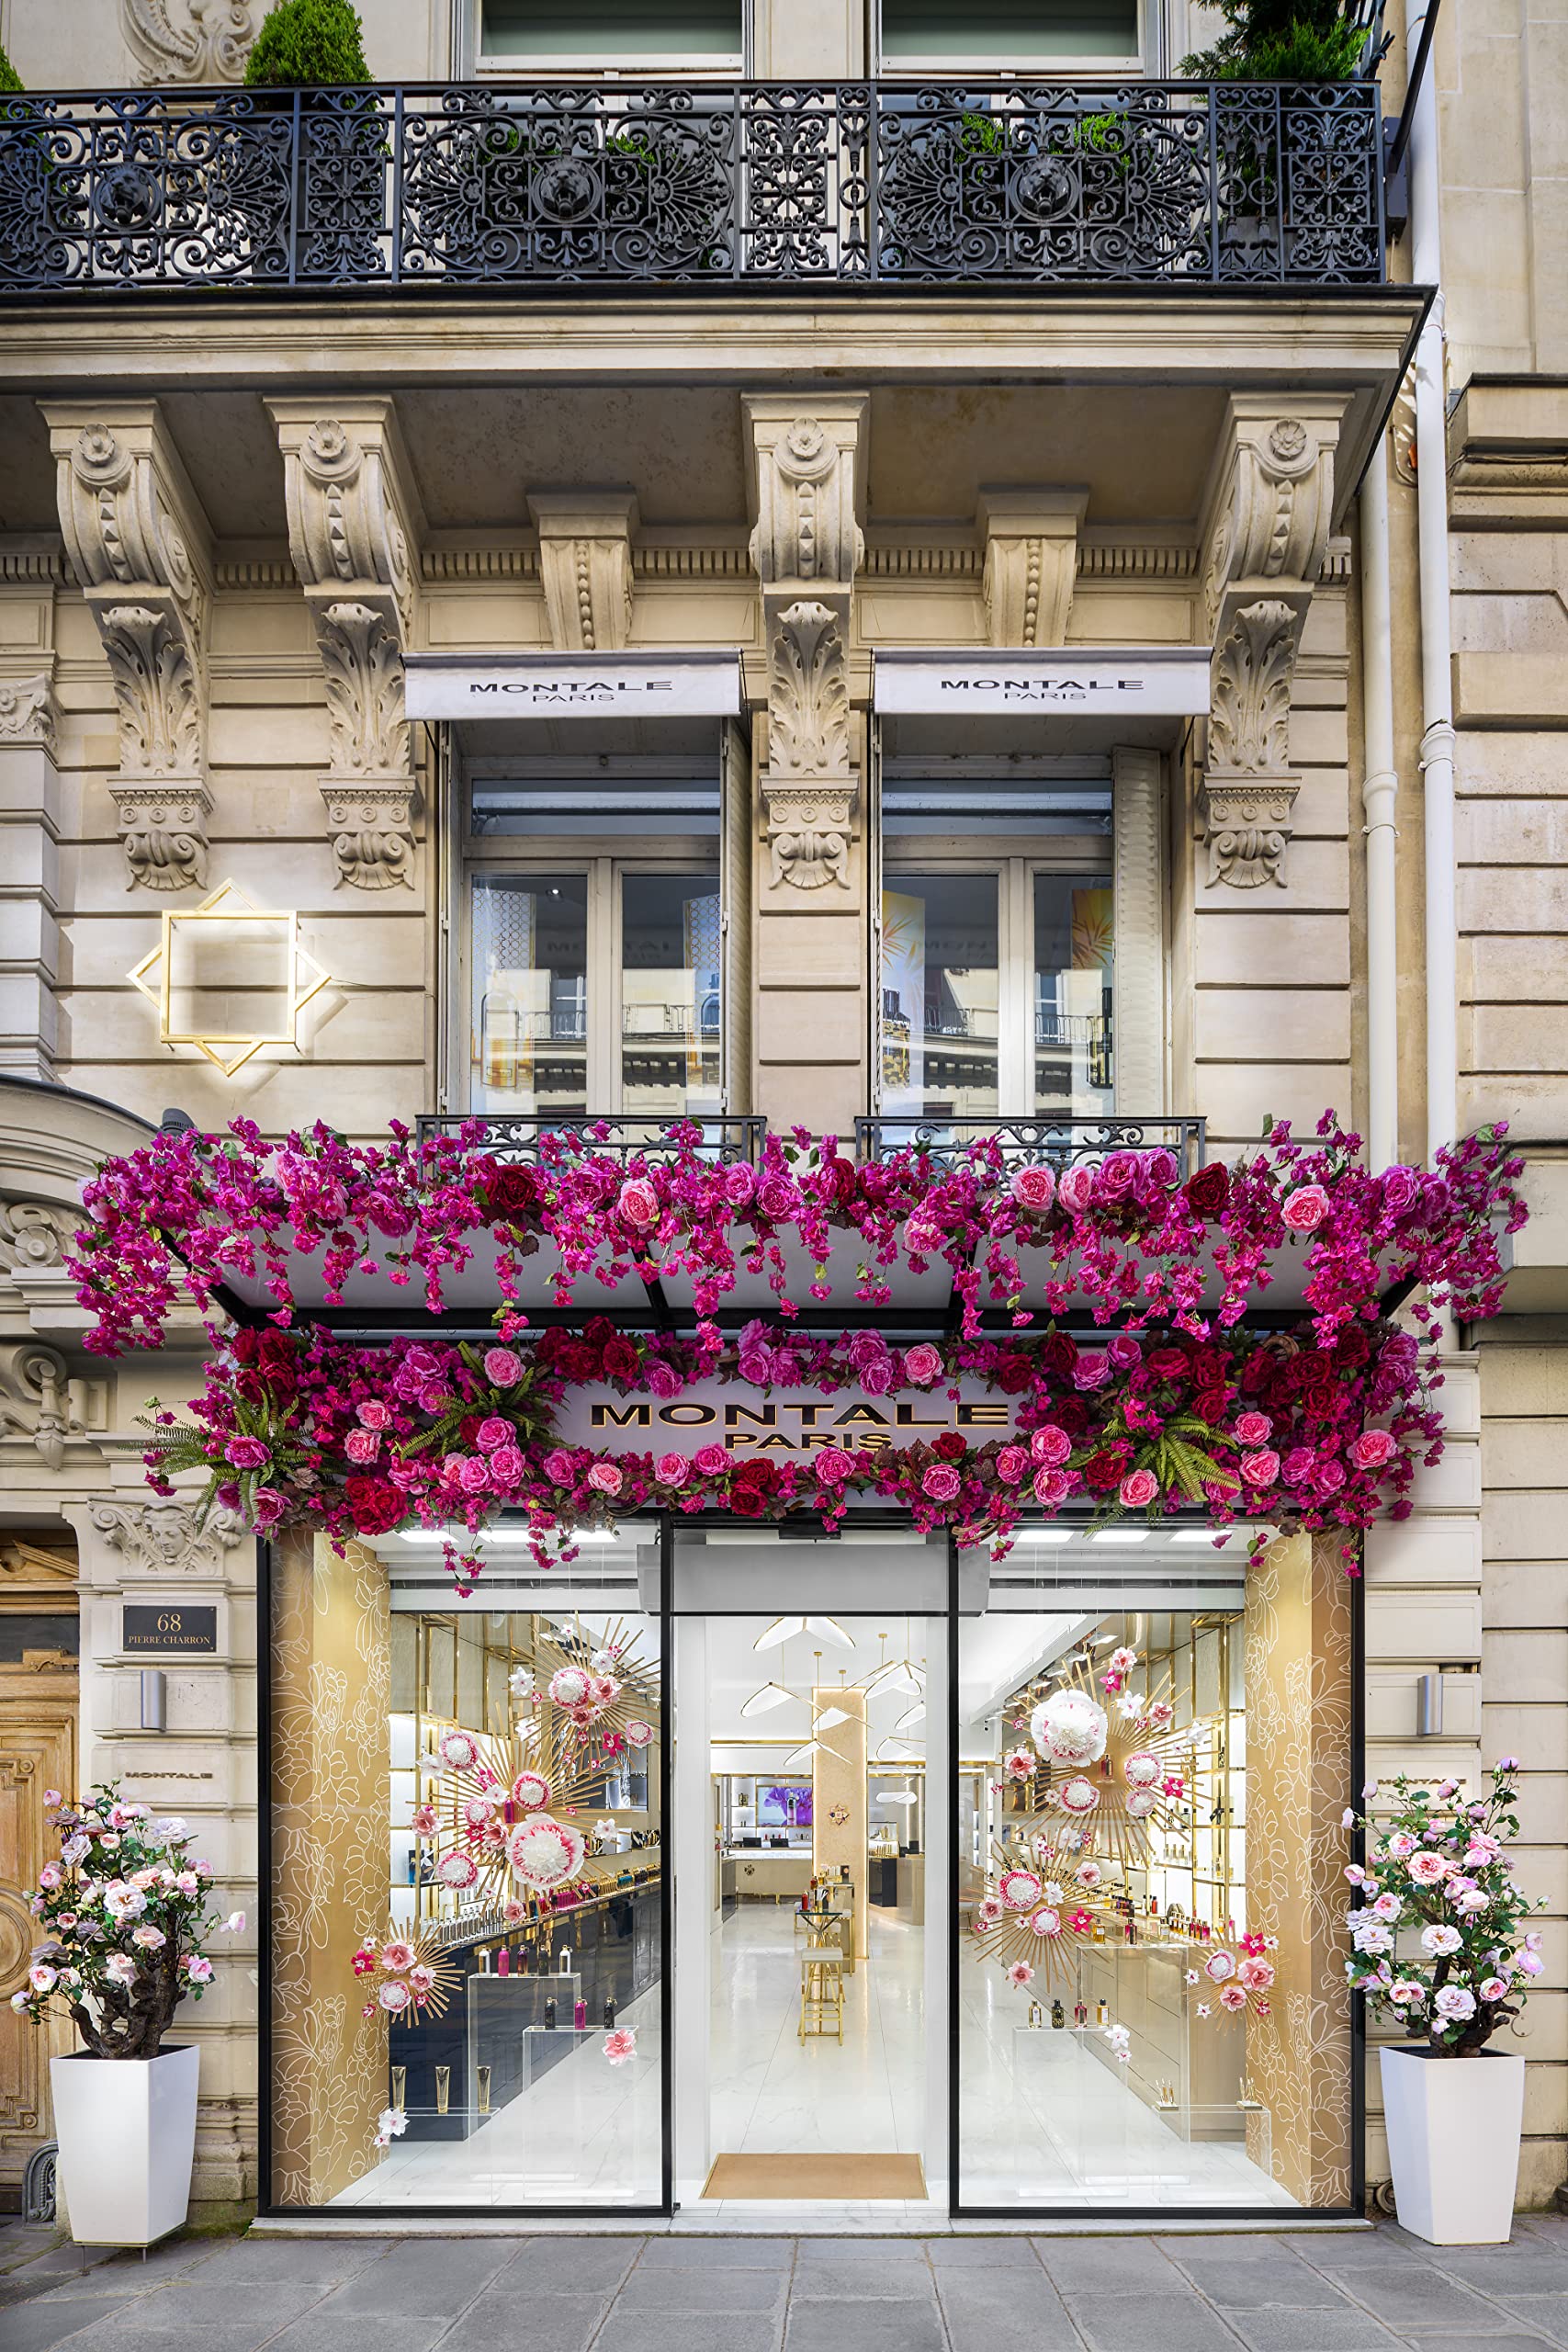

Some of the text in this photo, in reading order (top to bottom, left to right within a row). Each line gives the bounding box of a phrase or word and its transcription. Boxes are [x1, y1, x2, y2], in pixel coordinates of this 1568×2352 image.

[469, 681, 672, 693] MONTALE
[941, 680, 1144, 690] MONTALE
[532, 694, 615, 703] PARIS
[1004, 692, 1086, 700] PARIS
[590, 1403, 1010, 1427] MONTALE
[724, 1432, 892, 1451] PARIS
[157, 1613, 182, 1632] 68
[129, 1635, 211, 1645] PIERRE CHARRON
[125, 1771, 213, 1780] MONTALE
